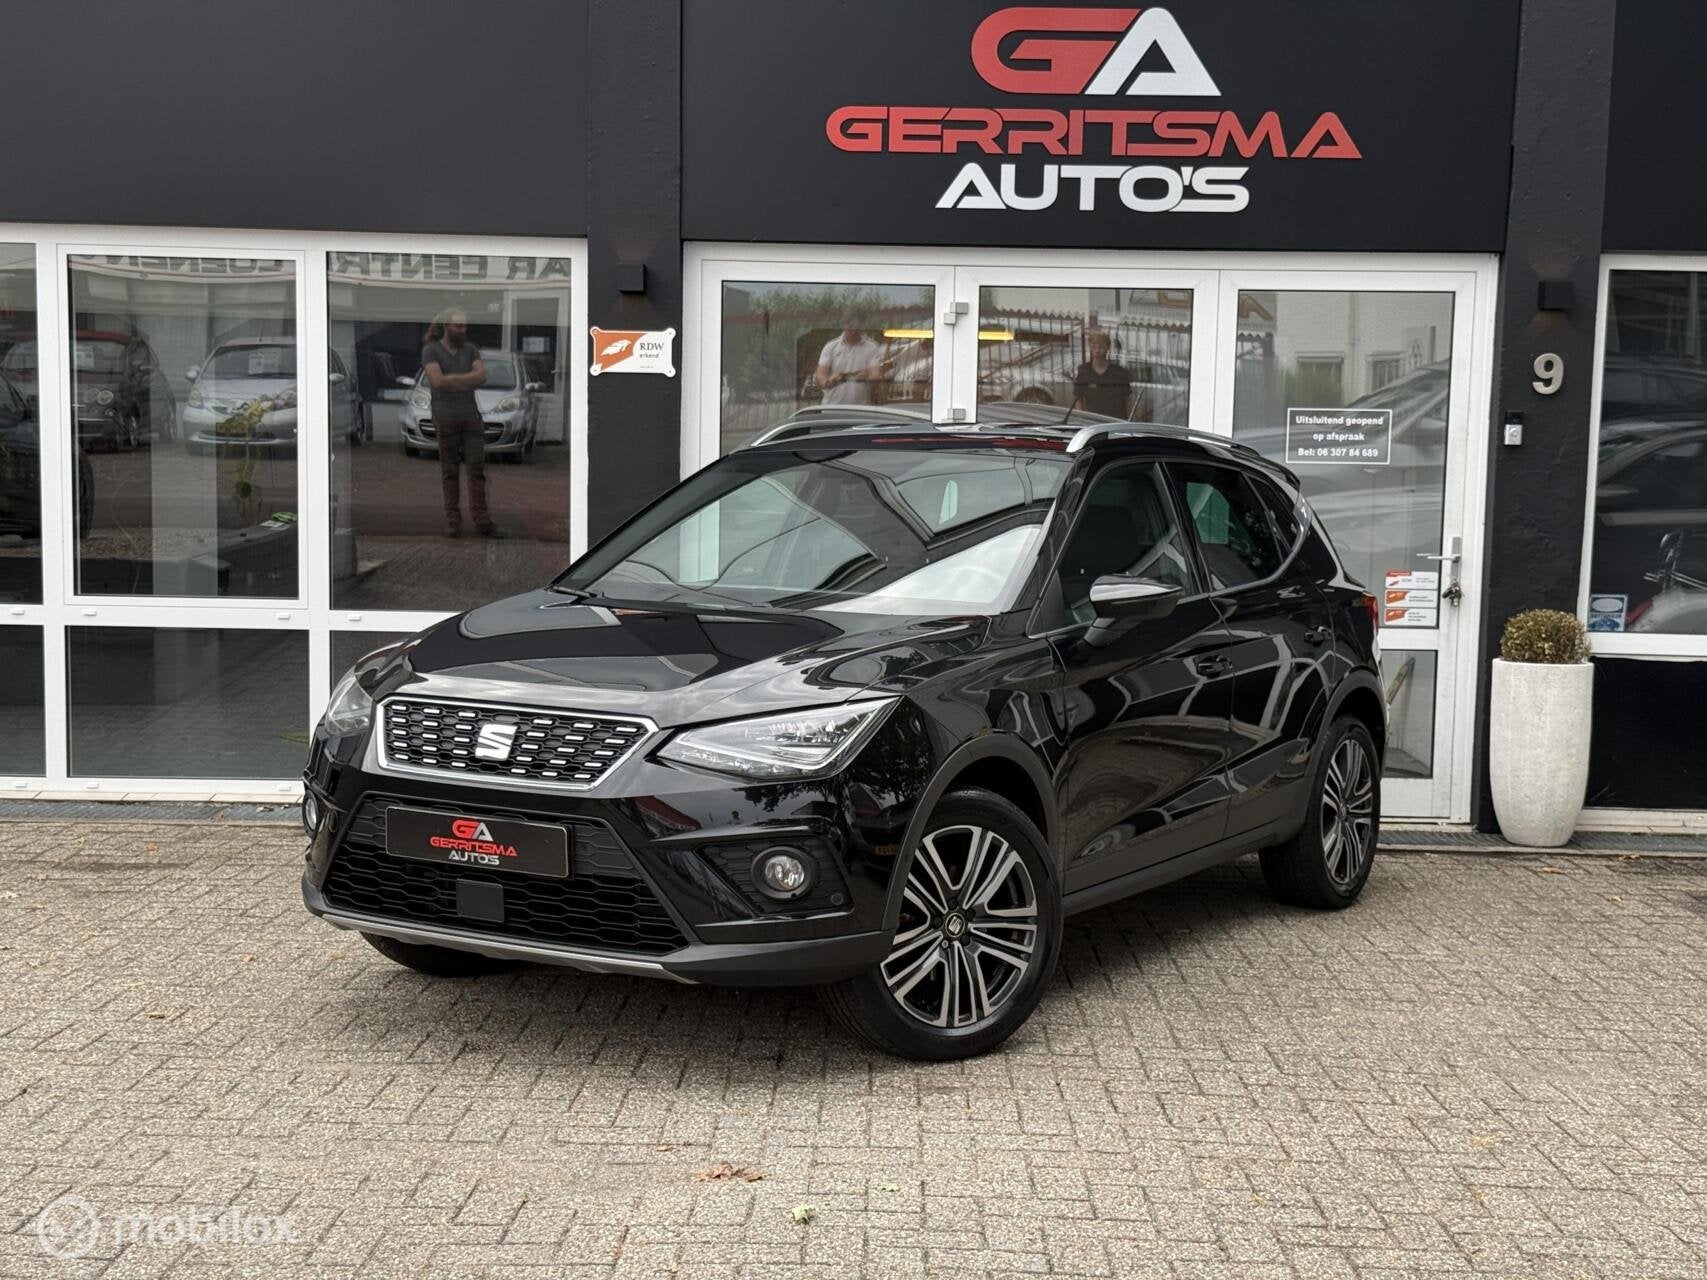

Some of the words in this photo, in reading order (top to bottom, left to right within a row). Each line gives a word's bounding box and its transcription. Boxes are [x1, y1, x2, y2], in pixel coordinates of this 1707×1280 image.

[971, 6, 1222, 96] GA
[825, 105, 1363, 159] GERRITSMA
[934, 162, 1250, 213] AUTO'S
[639, 342, 664, 351] RDW
[1532, 352, 1564, 395] 9
[1295, 415, 1344, 425] Uitsluitend
[1345, 416, 1384, 427] geopend
[1312, 433, 1325, 442] op
[1326, 432, 1366, 443] afspraak
[1297, 447, 1315, 456] Bel:
[1317, 448, 1328, 457] 06
[1330, 448, 1347, 457] 307
[1361, 448, 1379, 457] 689
[452, 819, 494, 841] GA
[429, 836, 518, 857] GERRITSMA
